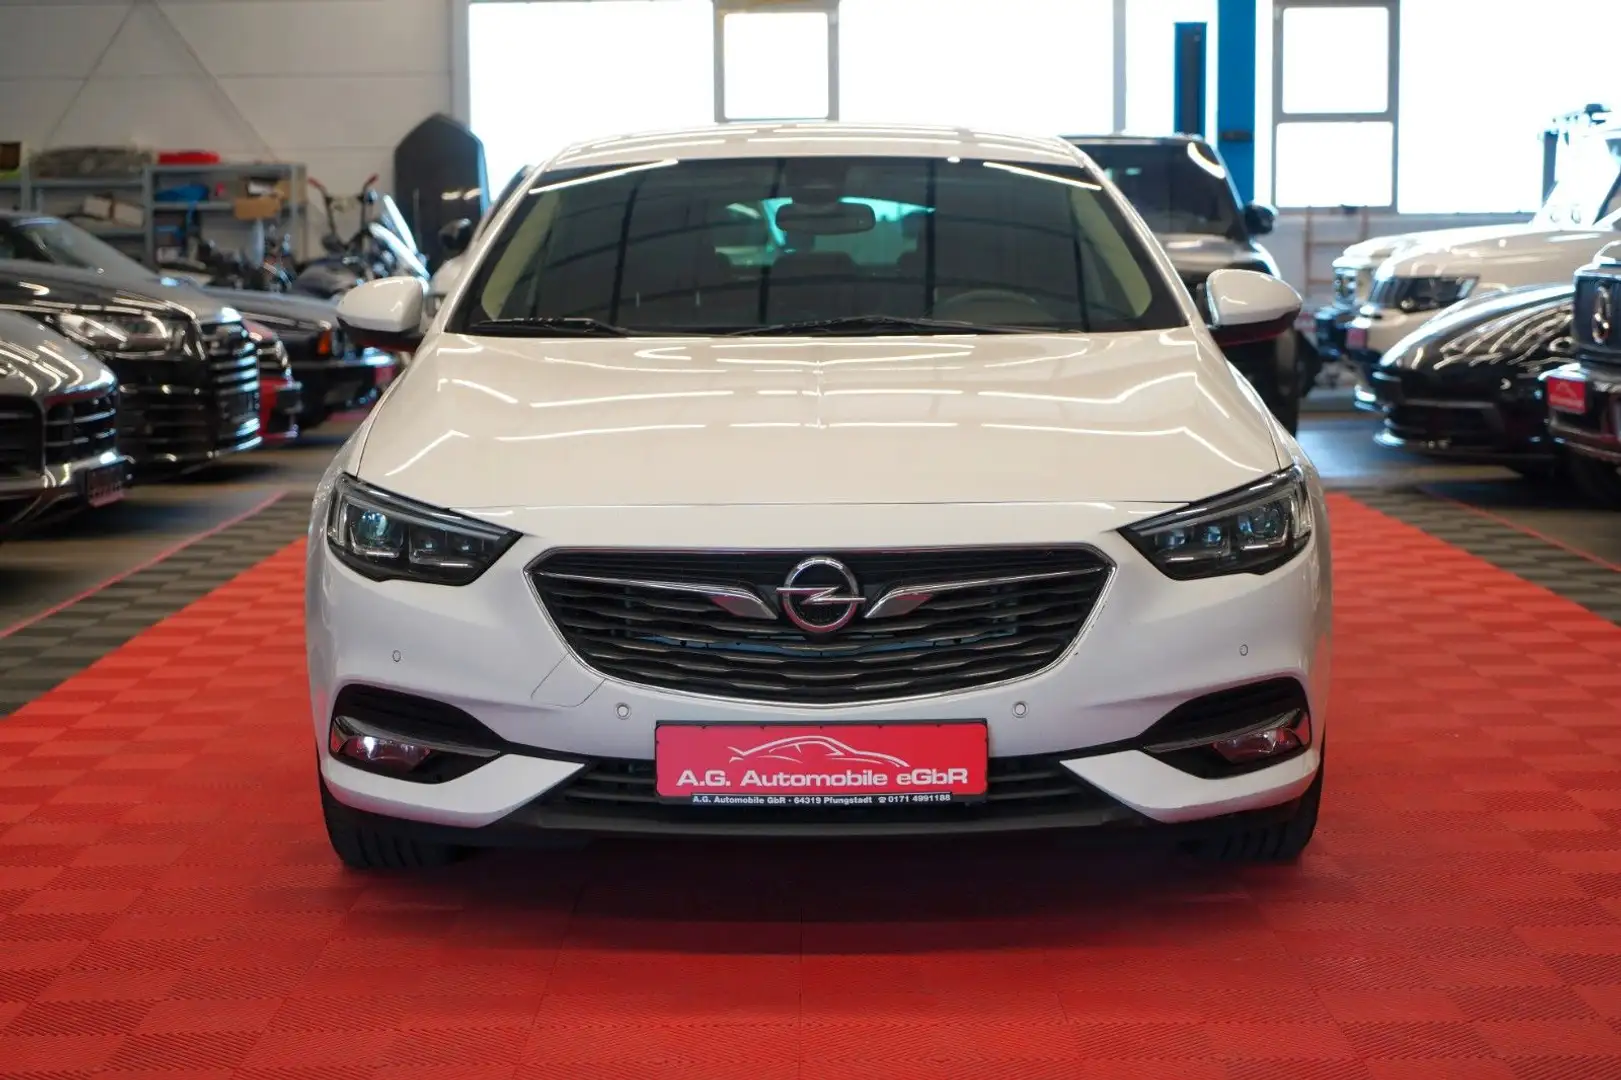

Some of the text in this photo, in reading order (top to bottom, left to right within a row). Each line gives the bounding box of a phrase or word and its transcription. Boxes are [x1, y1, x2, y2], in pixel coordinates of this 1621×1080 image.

[676, 768, 969, 787] A.G. Automobile eGbR
[714, 796, 765, 804] Automobile
[912, 794, 951, 802] 4991188
